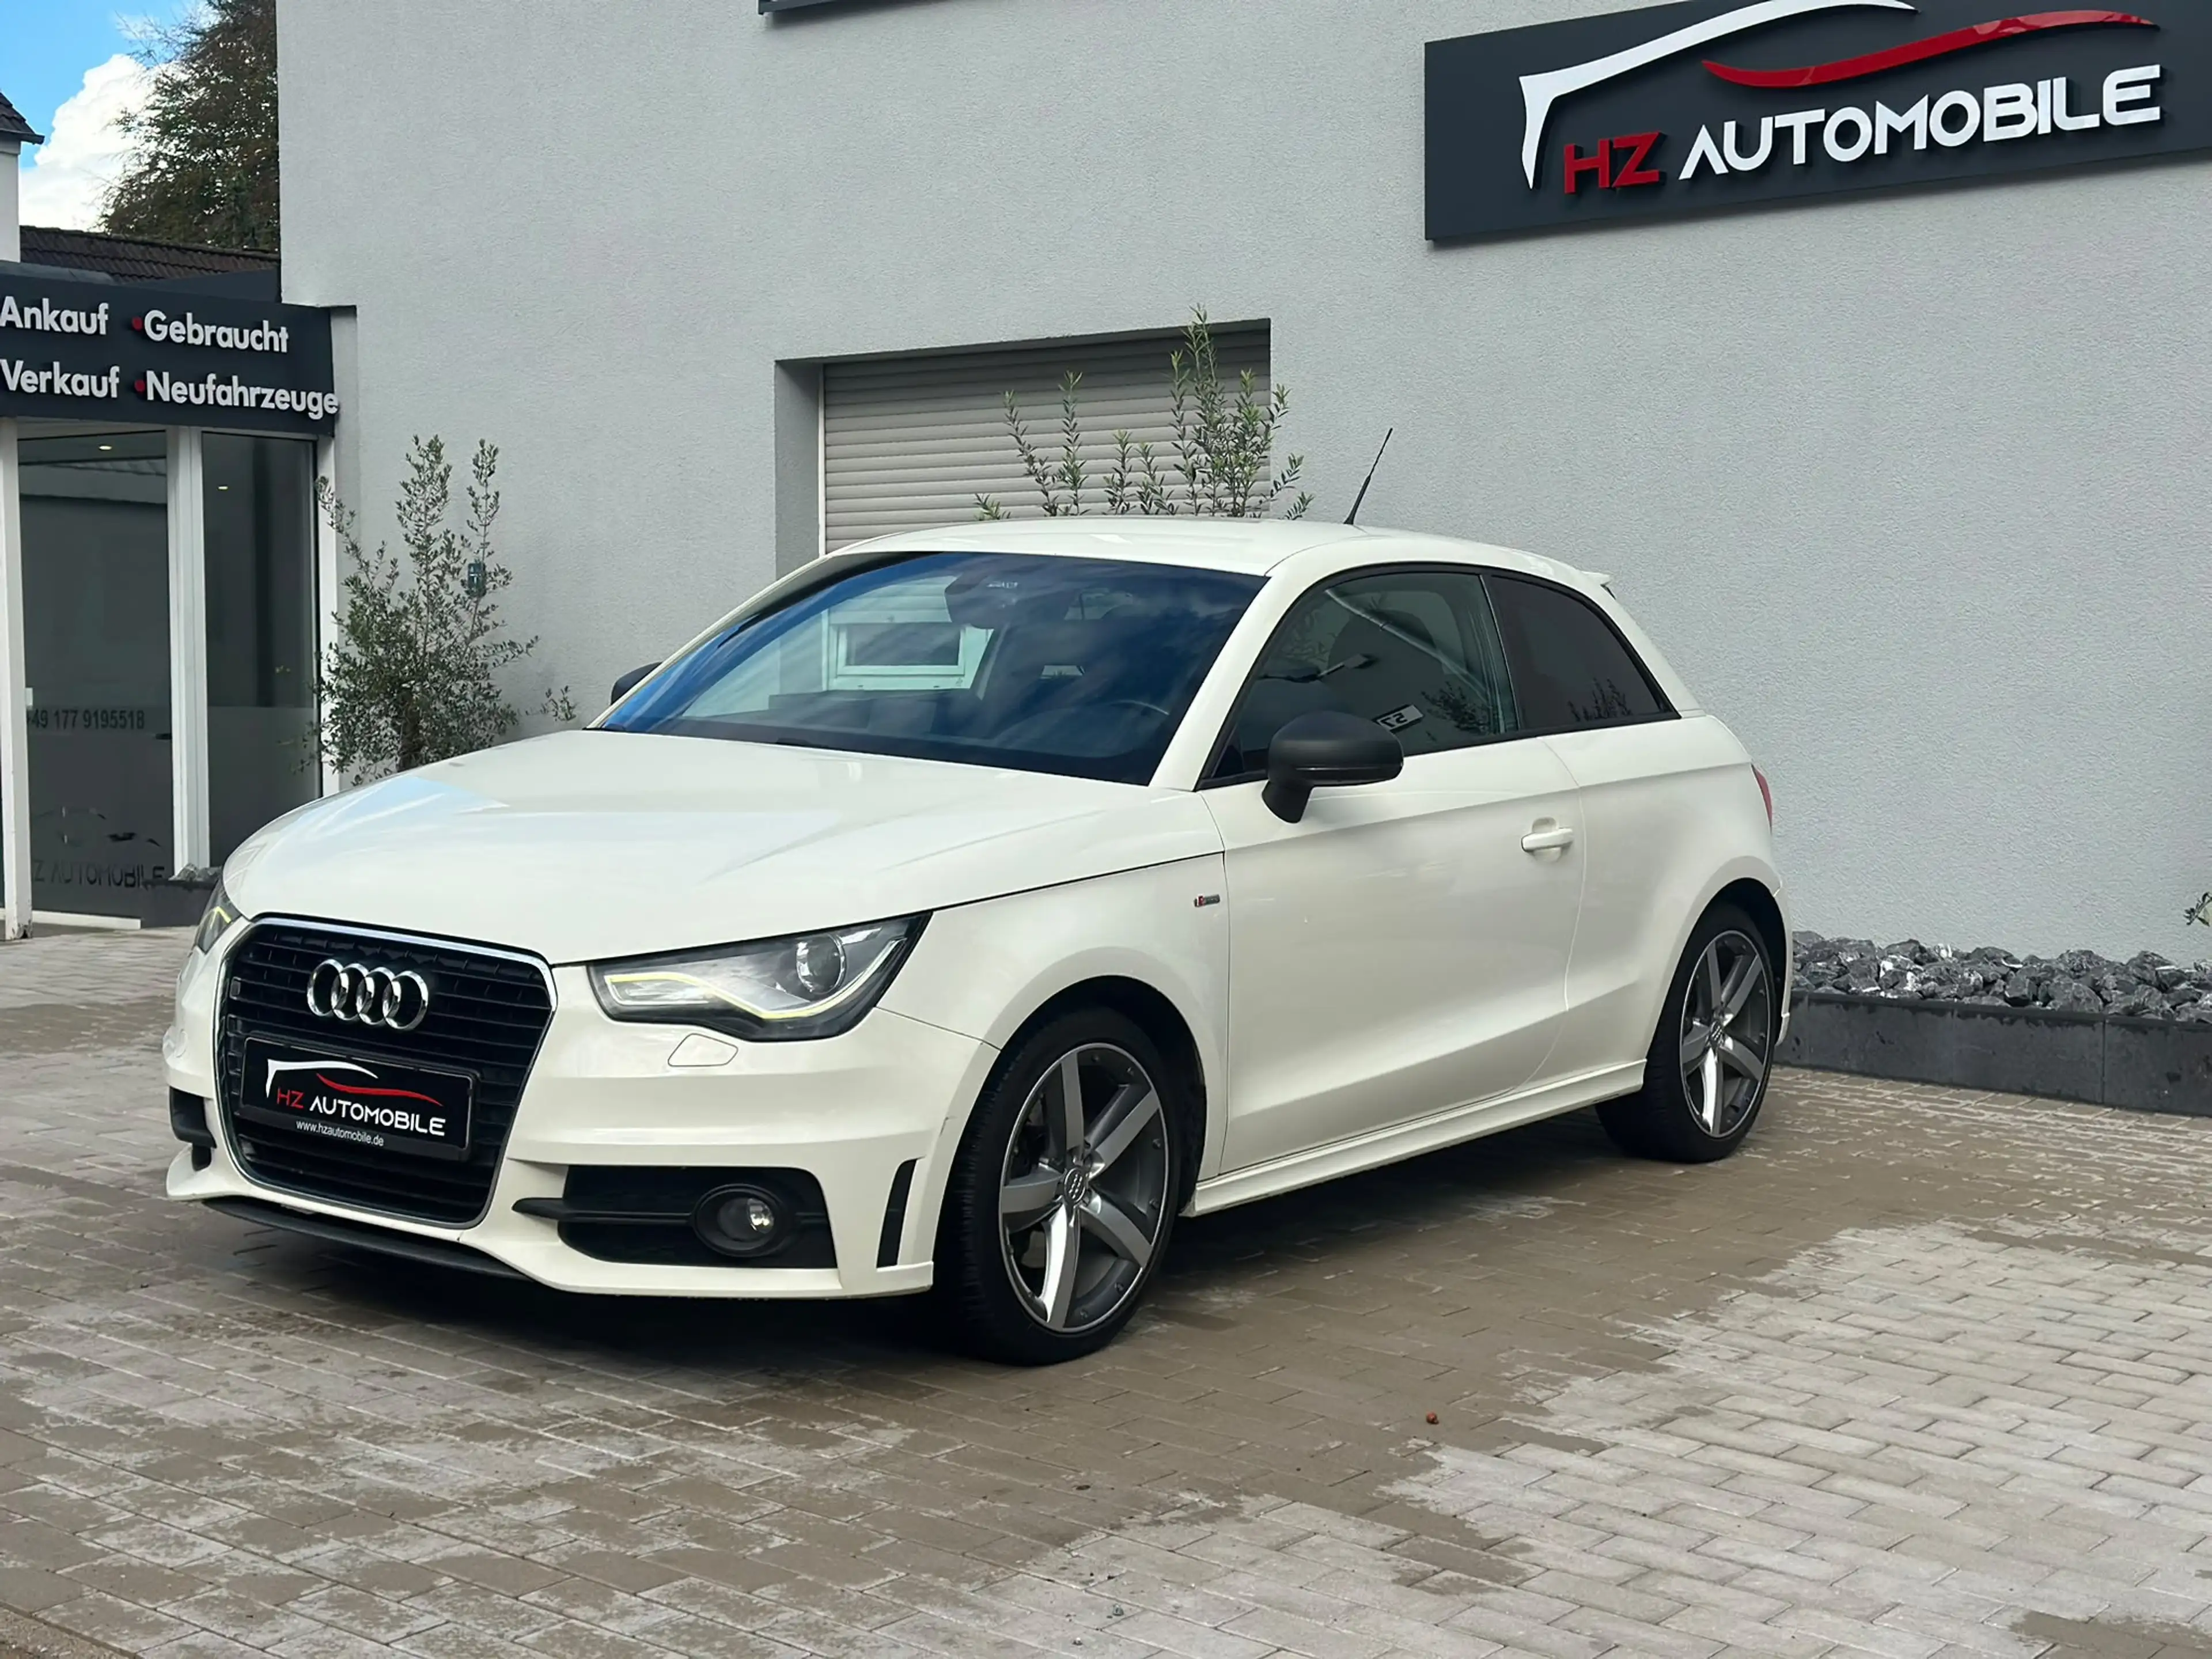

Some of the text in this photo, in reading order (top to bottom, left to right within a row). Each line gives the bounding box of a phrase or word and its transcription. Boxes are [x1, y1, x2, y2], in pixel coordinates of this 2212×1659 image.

[1563, 64, 2161, 194] HZ AUTOMOBILE
[0, 296, 289, 353] Ankauf Gebraucht
[0, 358, 339, 420] Verkauf Neufahrzeuge
[54, 709, 78, 729] 177
[83, 709, 145, 730] 9195518
[276, 1088, 446, 1137] HZ AUTOMOBILE
[296, 1120, 384, 1146] www.hzautomobile.de
